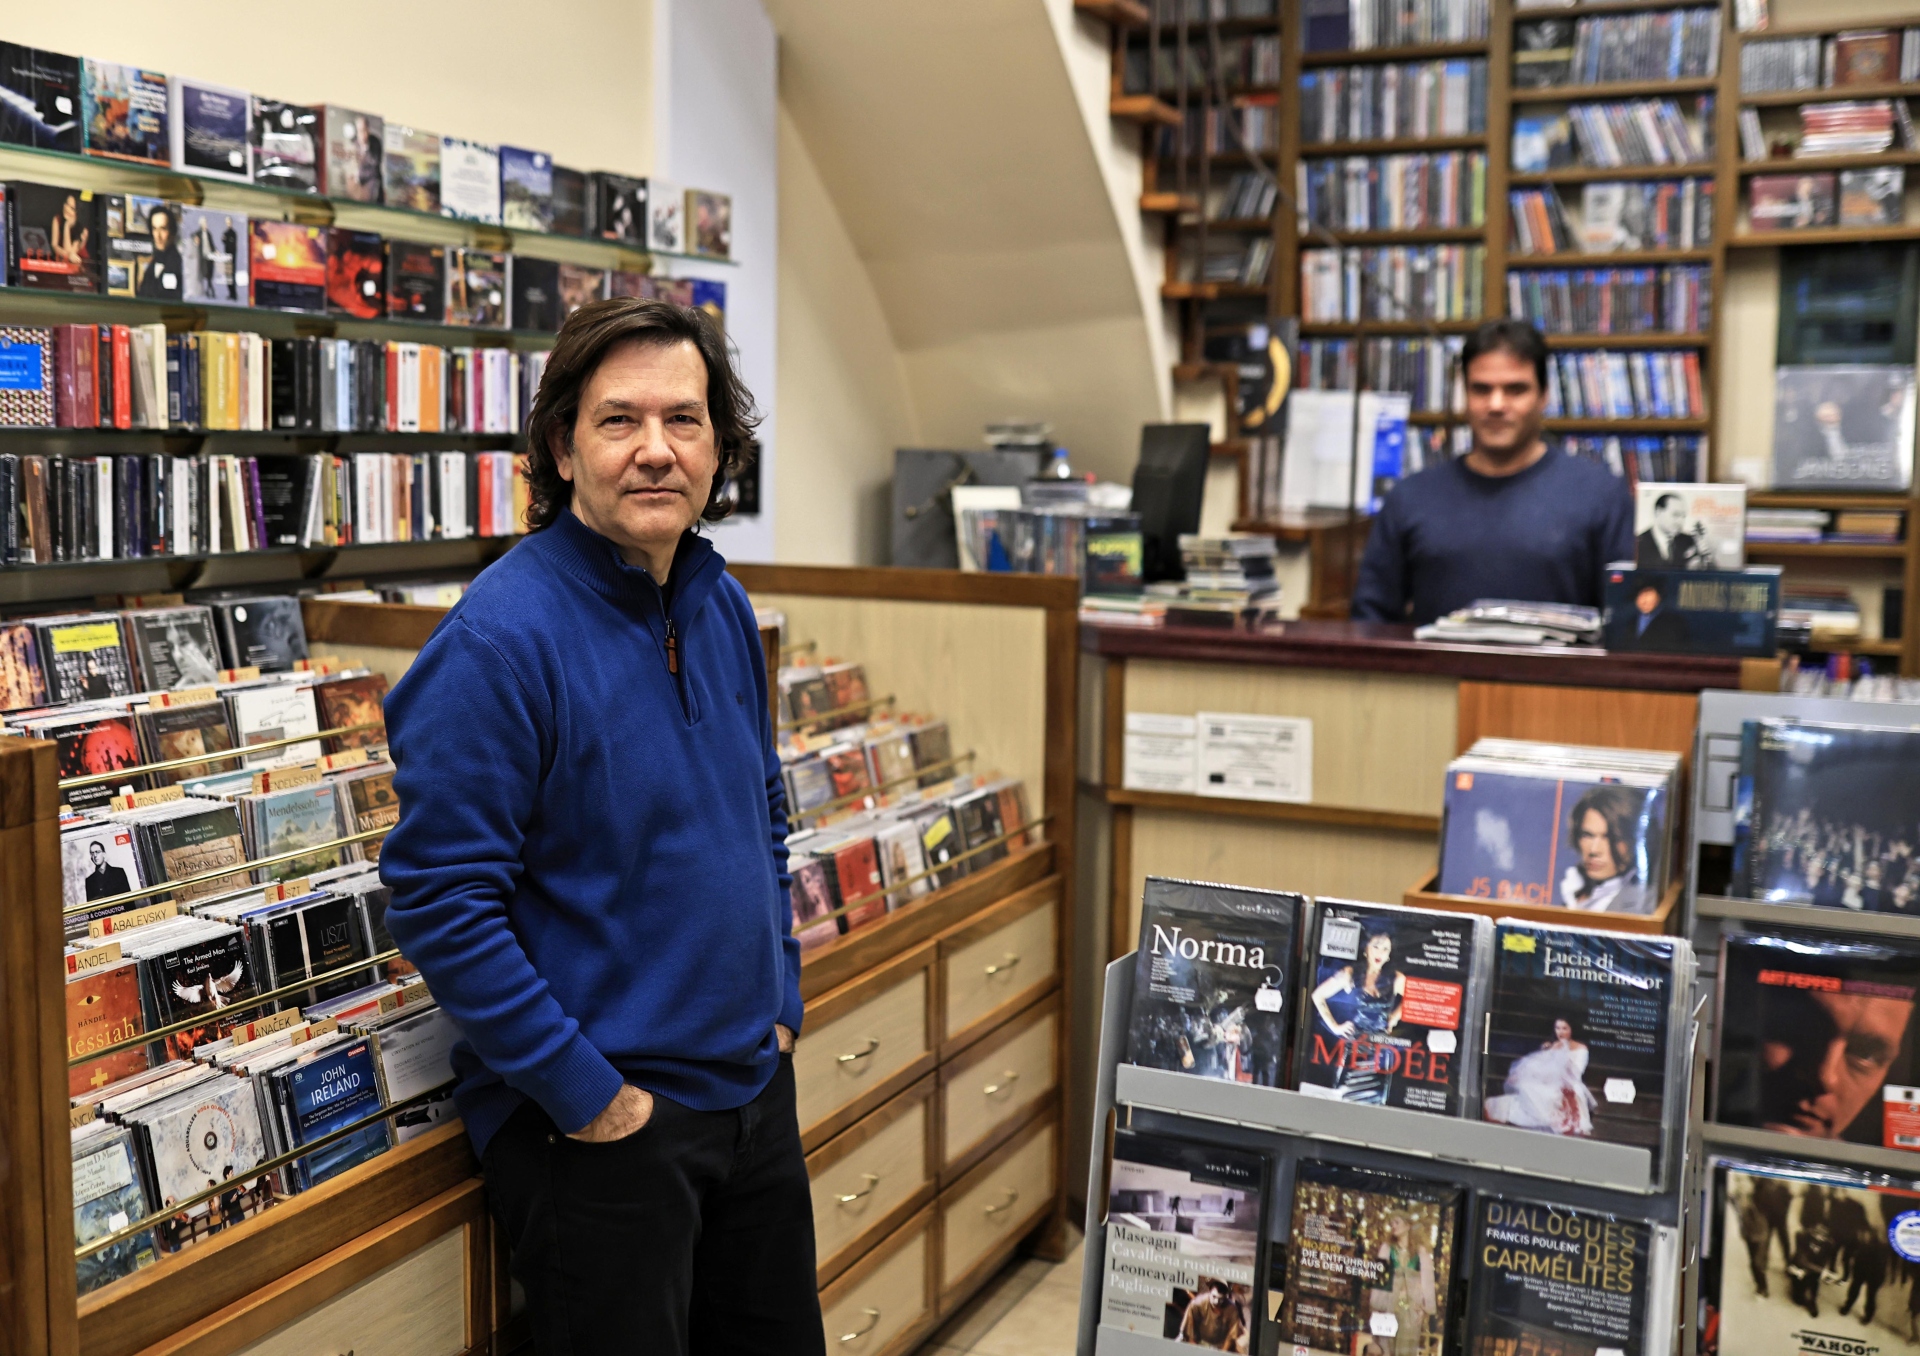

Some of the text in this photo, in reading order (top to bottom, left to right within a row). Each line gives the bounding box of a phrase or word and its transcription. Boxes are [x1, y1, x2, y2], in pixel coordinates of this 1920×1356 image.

[268, 798, 320, 818] Mendelssohn
[360, 808, 400, 831] Myslive
[1465, 876, 1551, 906] JS BACH
[63, 914, 89, 926] COMPOSER
[94, 905, 125, 918] CONDUCTOR
[104, 909, 168, 934] KABALEVSKY
[321, 922, 348, 947] LISZT
[1150, 924, 1265, 970] Norma
[68, 952, 112, 974] HANDEL
[184, 948, 226, 966] The Armed Man
[1545, 946, 1614, 969] Lucia di
[1544, 960, 1663, 990] Lammermoor
[1786, 972, 1842, 992] PEPPER
[1311, 1033, 1450, 1084] MÉDÉE
[321, 1064, 346, 1086] JOHN
[310, 1073, 360, 1106] IRELAND
[70, 1112, 96, 1128] ANCK
[93, 1154, 100, 1164] D
[1487, 1202, 1636, 1250] DIALOGUES
[1114, 1226, 1178, 1252] Mascagni
[1303, 1239, 1342, 1254] MOZART
[1486, 1228, 1634, 1271] FRANCIS POULENC DES
[1111, 1241, 1248, 1281] Cavalleria rusticana
[1302, 1249, 1318, 1258] DIE
[1111, 1258, 1194, 1287] Leoncavallo
[1301, 1258, 1378, 1280] AUS DEM SERAIL
[1484, 1244, 1633, 1293] CARMÉLITES
[1110, 1273, 1169, 1299] Pagliacci
